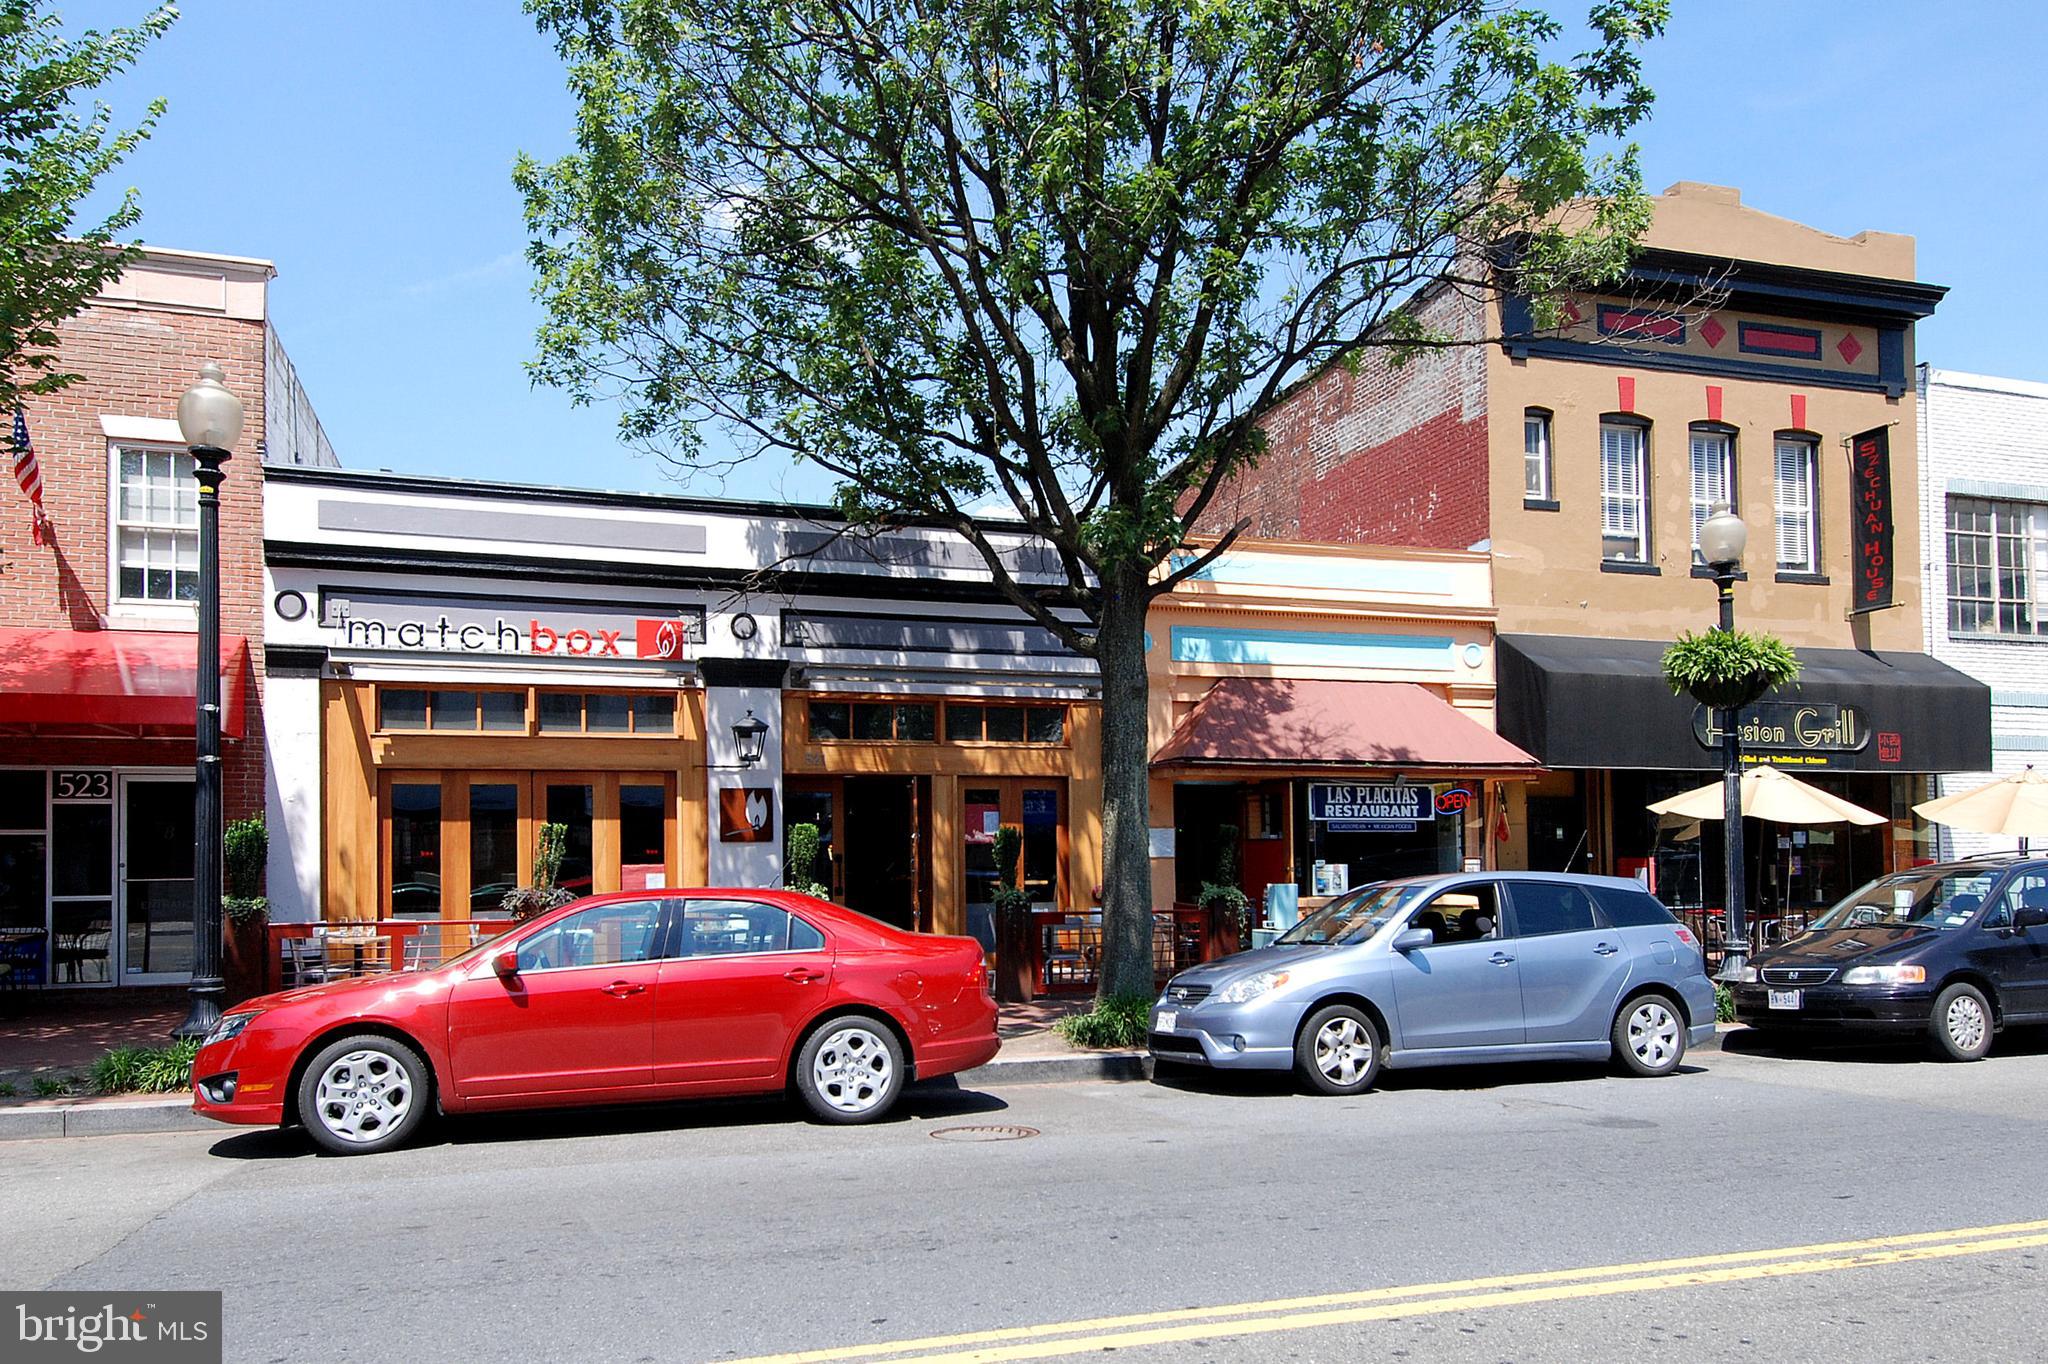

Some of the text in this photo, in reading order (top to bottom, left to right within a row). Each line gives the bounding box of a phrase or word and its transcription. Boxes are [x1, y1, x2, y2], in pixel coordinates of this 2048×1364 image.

[1860, 440, 1885, 600] SZECHUAN HOUSE
[1706, 706, 1785, 746] Fsion
[1794, 707, 1855, 748] Grill
[58, 773, 109, 797] 523
[1326, 786, 1419, 804] LAS PLACITAS
[1325, 804, 1420, 817] RESTAURANT
[1435, 793, 1472, 810] OPEN
